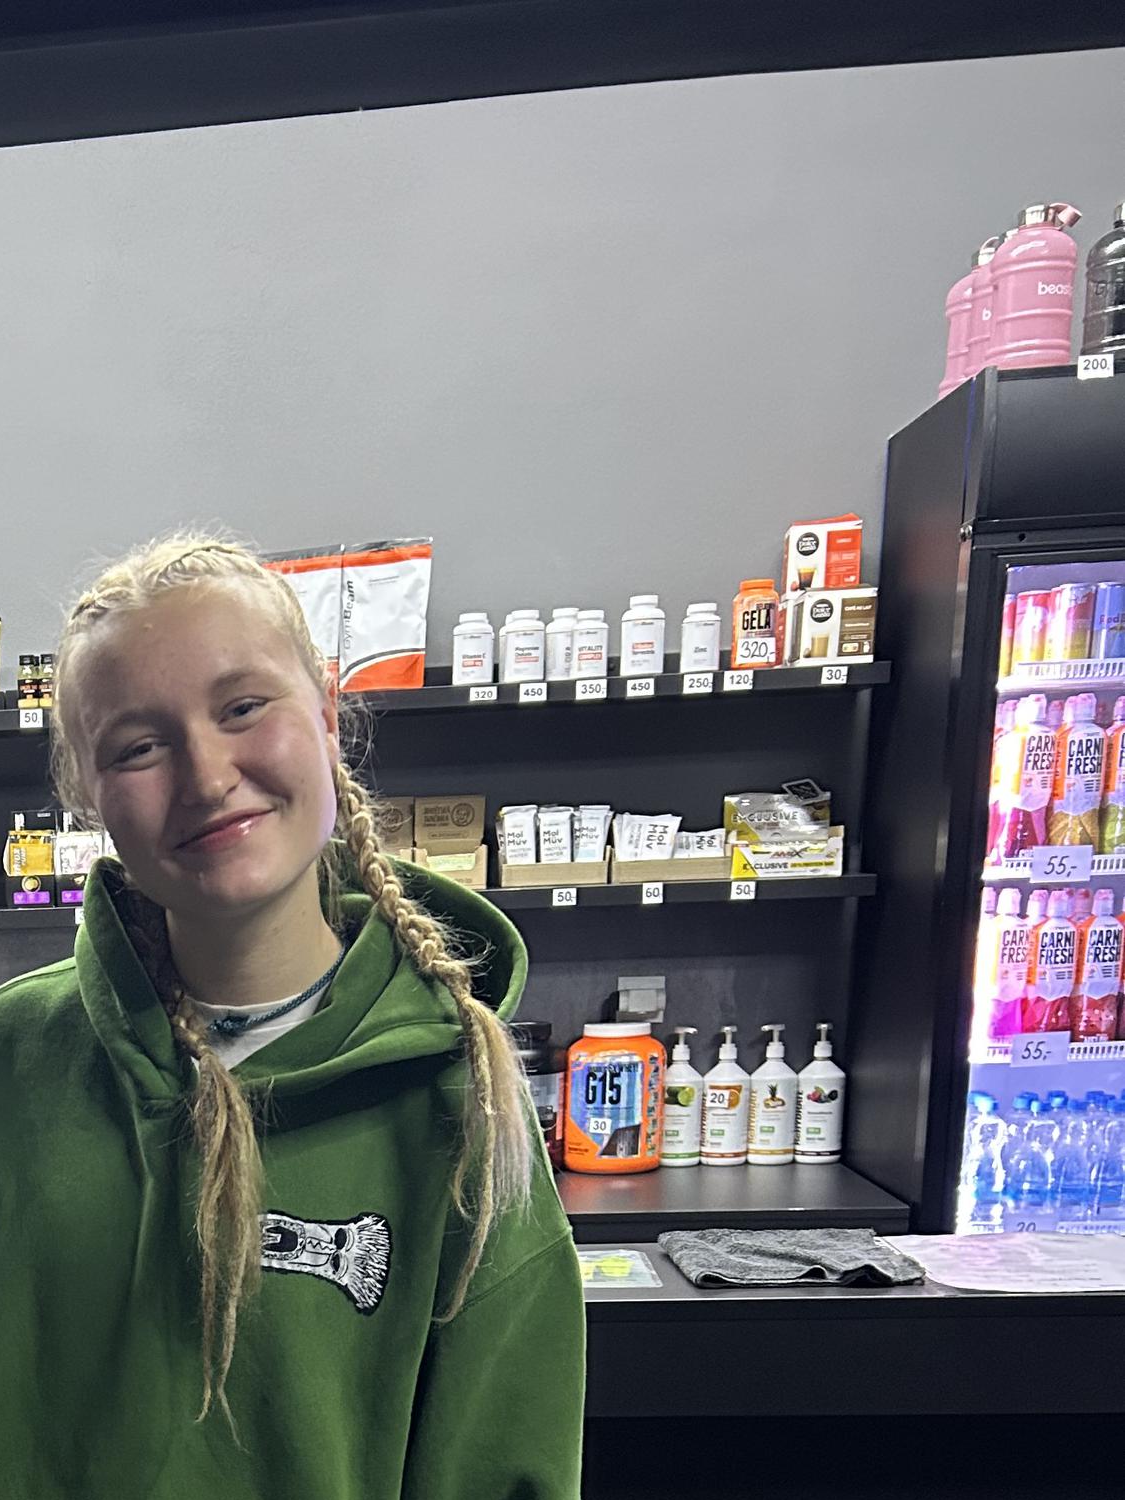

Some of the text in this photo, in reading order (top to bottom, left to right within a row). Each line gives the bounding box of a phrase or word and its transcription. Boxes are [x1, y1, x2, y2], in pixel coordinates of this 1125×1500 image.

[474, 690, 493, 699] 320
[523, 687, 543, 697] 450
[631, 682, 651, 691] 450
[1067, 756, 1102, 776] FRESH
[1044, 855, 1077, 877] 55,-
[1039, 948, 1073, 965] FRESH
[1021, 1041, 1052, 1061] 55,-
[584, 1071, 623, 1105] G15
